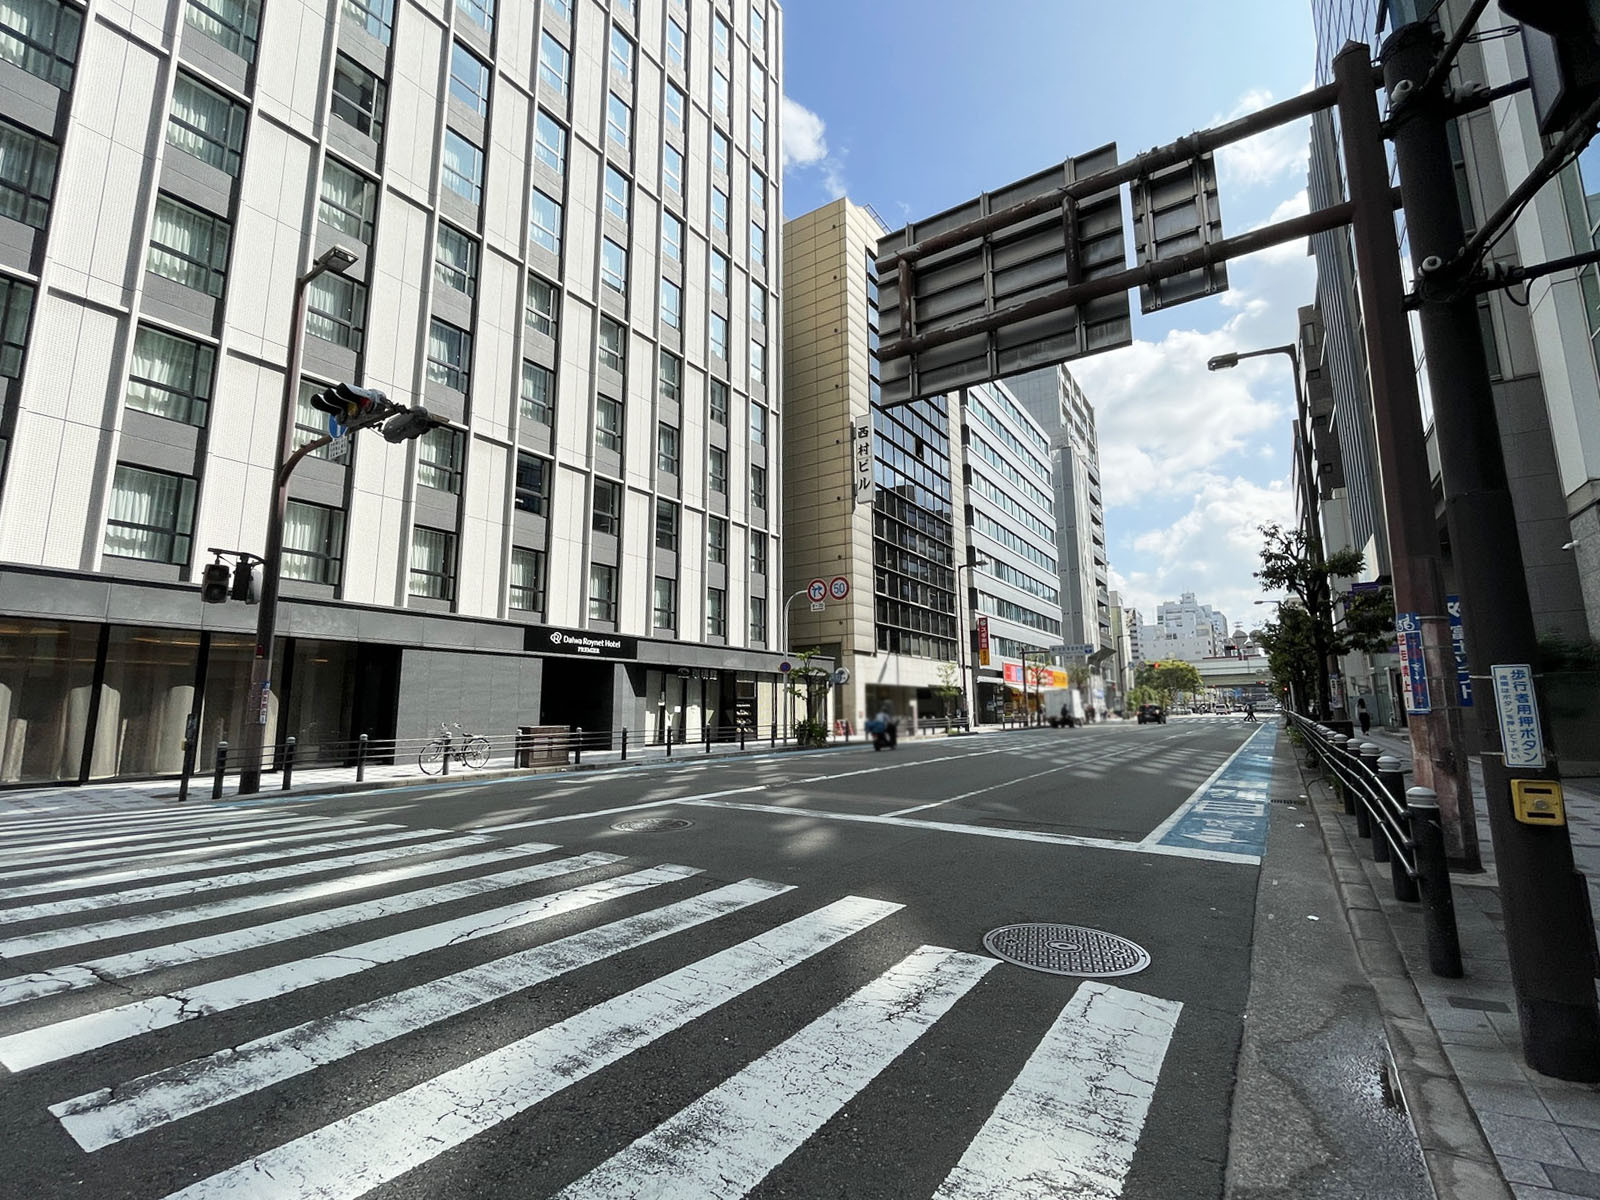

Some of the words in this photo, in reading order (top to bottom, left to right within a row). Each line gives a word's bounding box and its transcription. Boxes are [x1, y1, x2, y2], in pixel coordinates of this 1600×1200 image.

[858, 426, 871, 490] 西村ビル
[833, 582, 846, 594] 50
[563, 635, 583, 644] Daiwa
[583, 637, 604, 647] Roynet
[604, 639, 621, 648] Hotel
[1510, 669, 1538, 762] 歩行者用押ボタン
